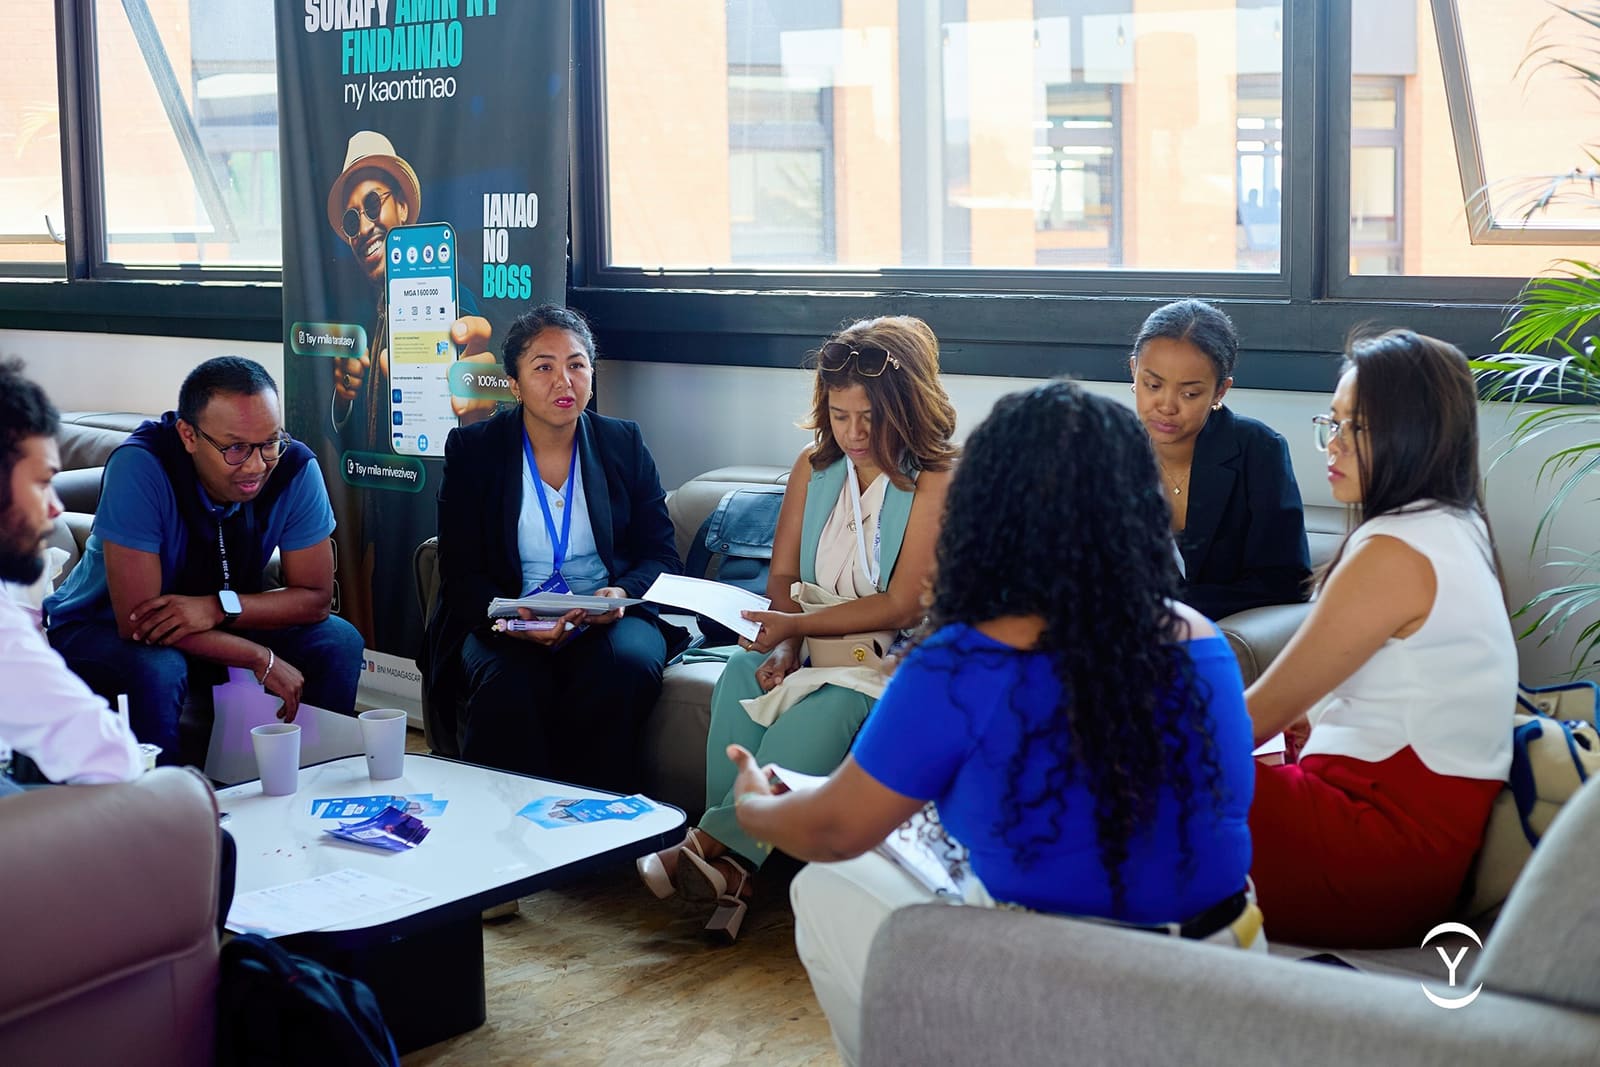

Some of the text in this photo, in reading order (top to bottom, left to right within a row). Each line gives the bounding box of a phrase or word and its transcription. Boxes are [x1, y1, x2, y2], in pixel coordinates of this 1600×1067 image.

[342, 20, 463, 75] FINDAINAO
[344, 71, 457, 110] ny kaontinao
[483, 193, 539, 228] IANAO
[483, 229, 509, 263] NO
[483, 264, 532, 299] BOSS
[305, 333, 317, 346] Tsy
[477, 375, 510, 388] 100% no
[355, 462, 367, 477] Tsy
[367, 464, 382, 476] mila
